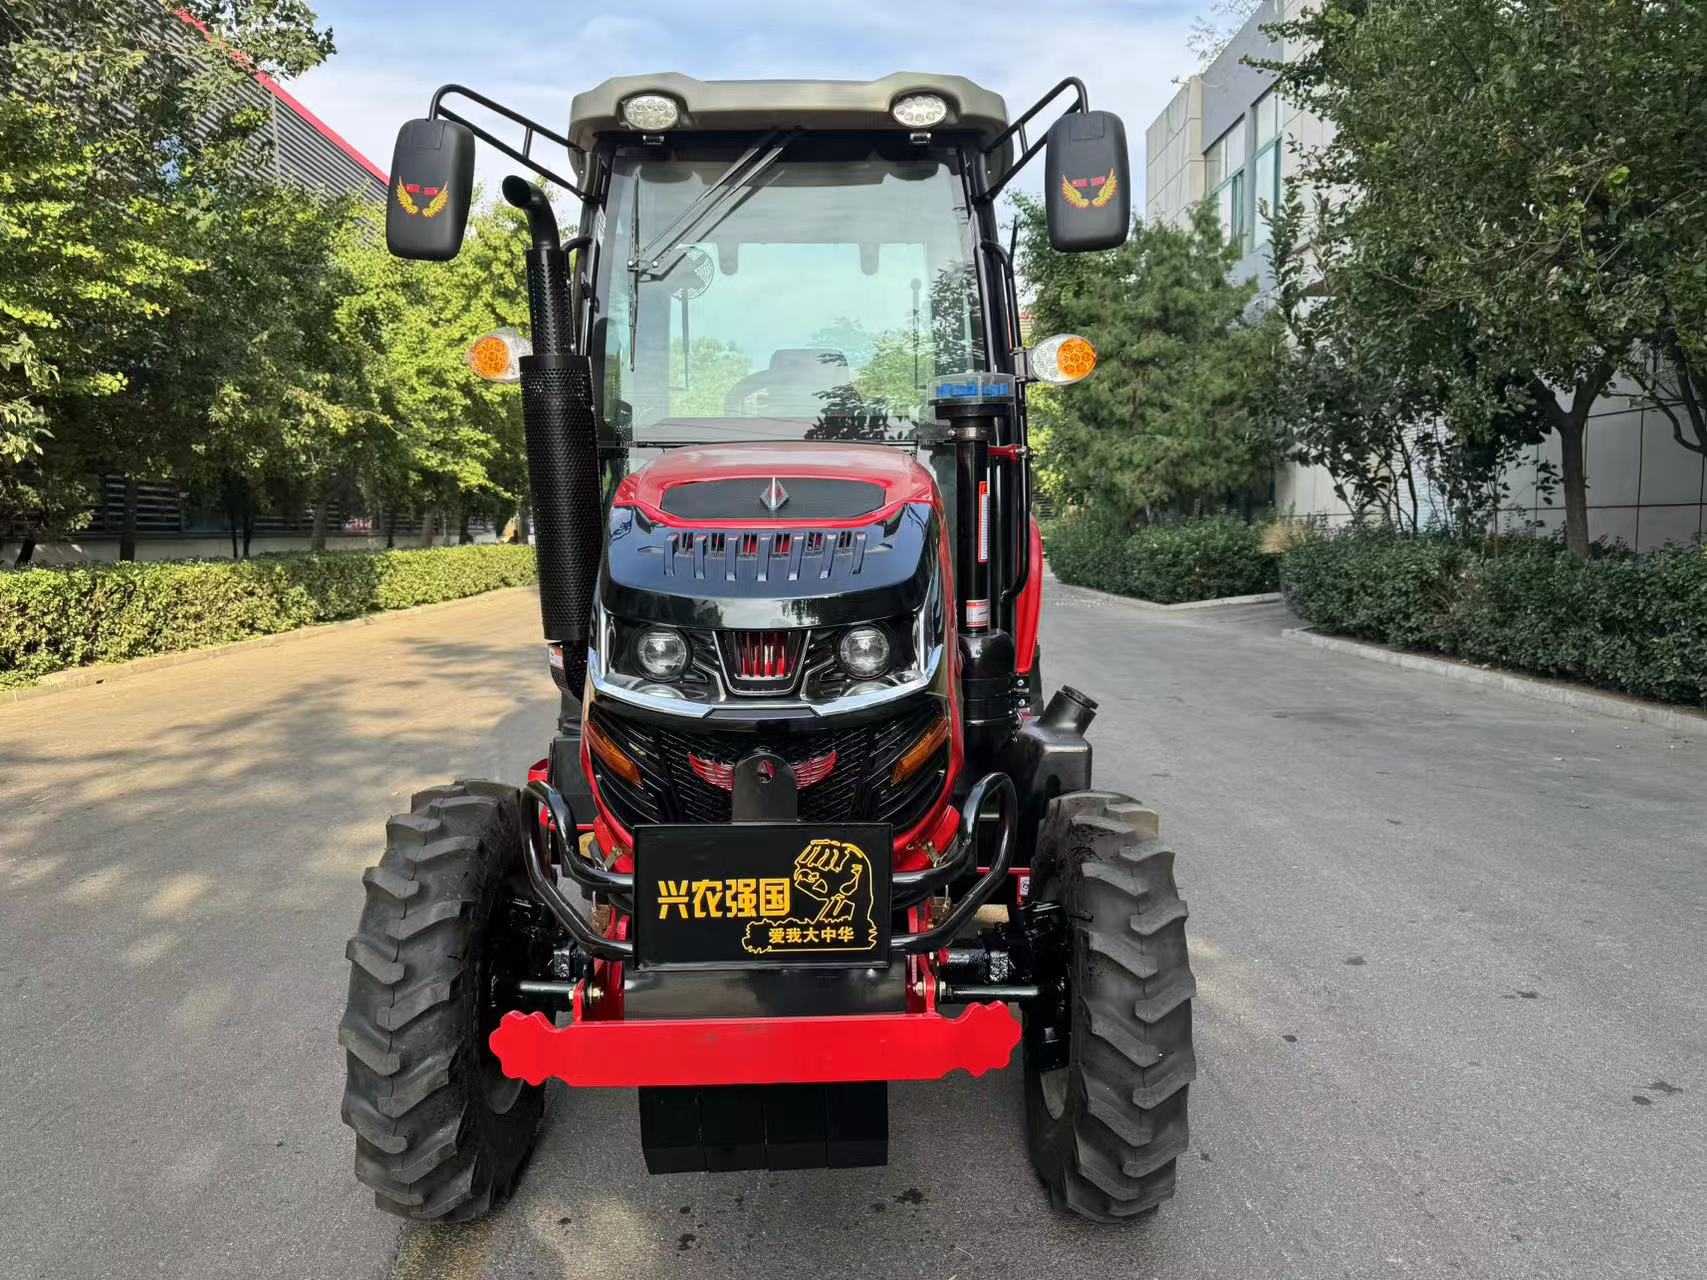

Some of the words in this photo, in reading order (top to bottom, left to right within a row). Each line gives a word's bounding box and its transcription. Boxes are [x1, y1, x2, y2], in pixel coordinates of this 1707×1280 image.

[657, 878, 790, 919] 兴农强国
[768, 926, 854, 943] 爱我大中华
